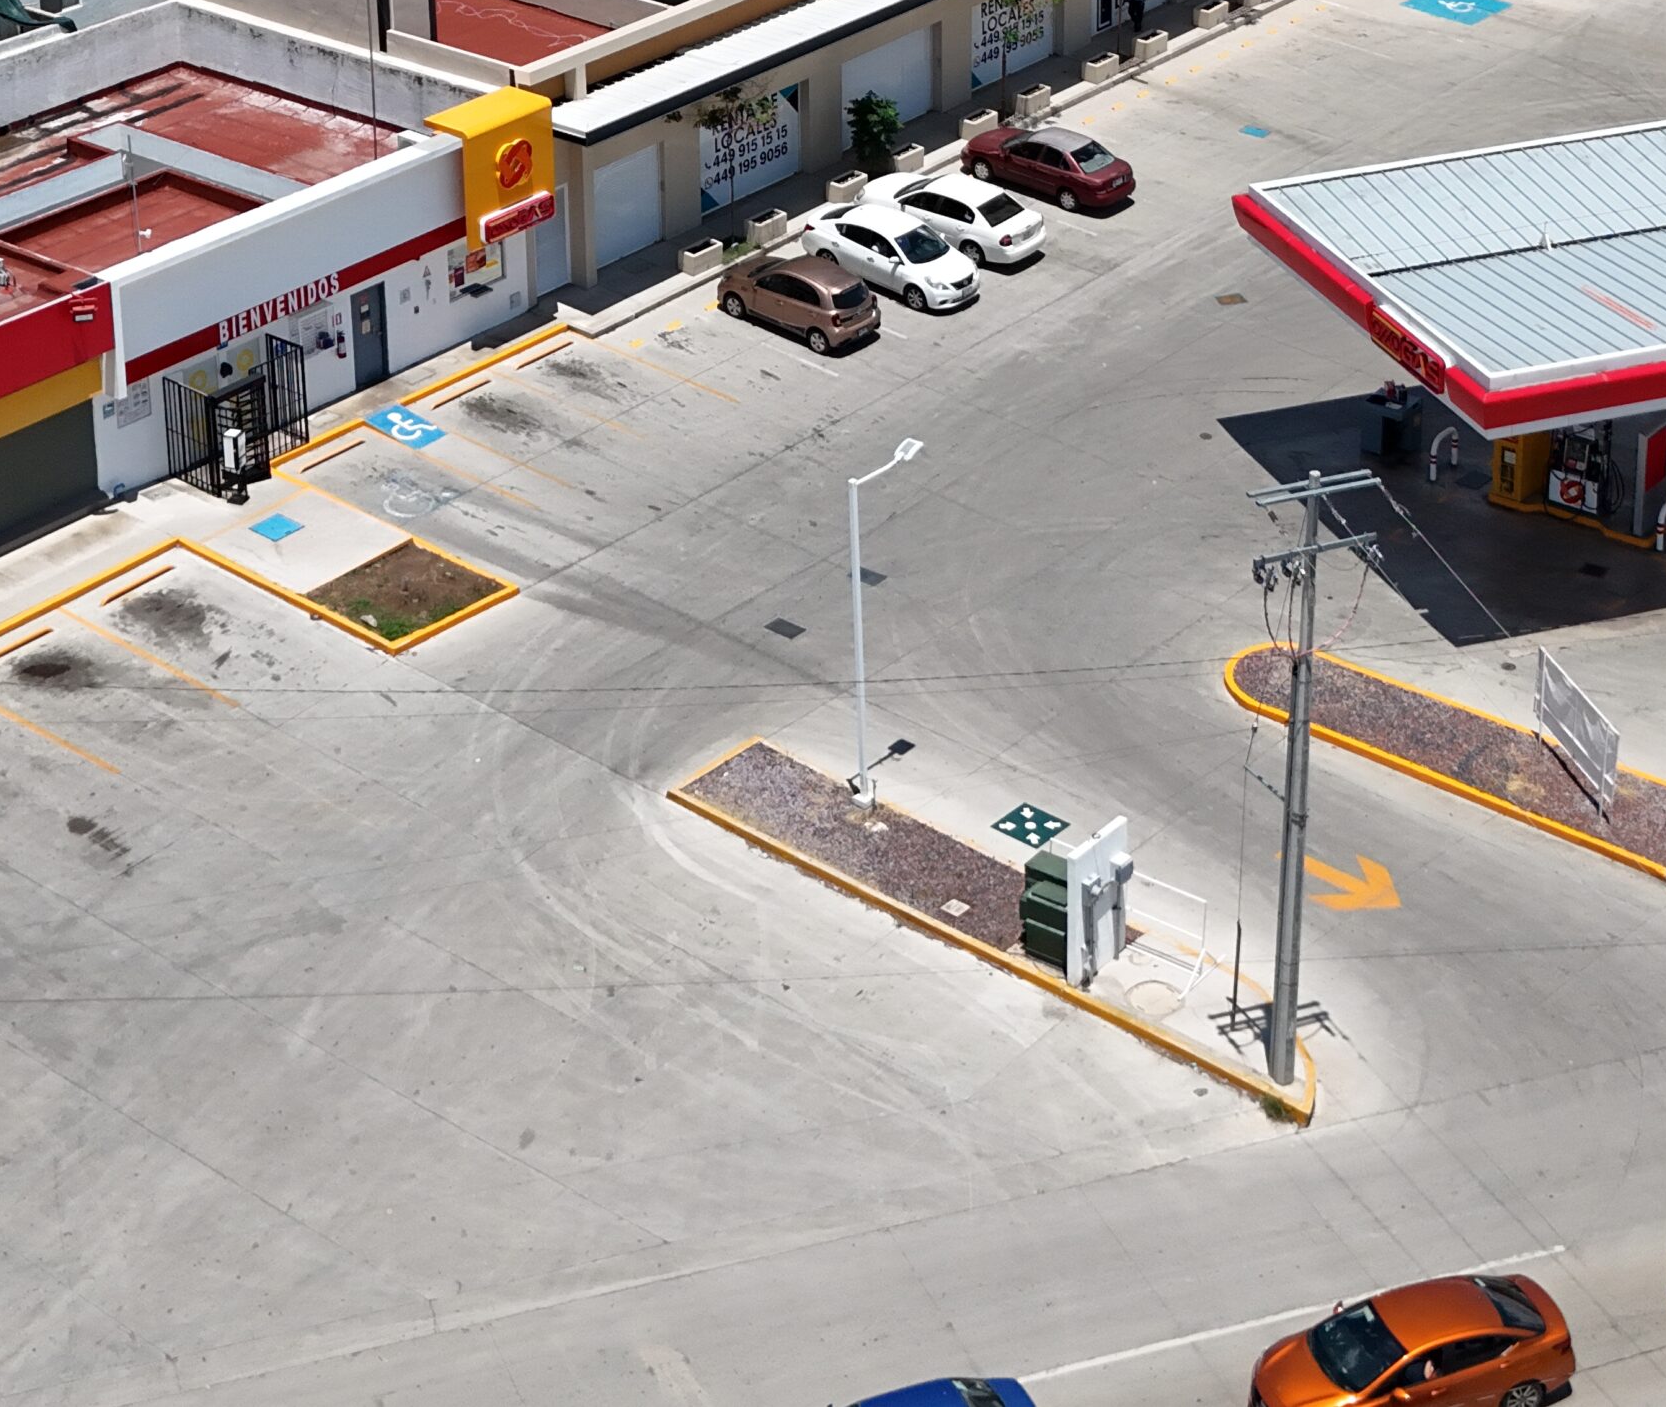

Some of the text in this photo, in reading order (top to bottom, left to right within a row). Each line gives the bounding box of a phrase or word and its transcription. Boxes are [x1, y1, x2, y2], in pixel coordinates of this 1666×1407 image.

[981, 31, 1000, 48] 449
[981, 47, 1000, 63] 449
[713, 125, 788, 167] 449 915 15 15
[713, 142, 788, 185] 449 195 9056
[219, 272, 340, 343] BIENVENIDOS
